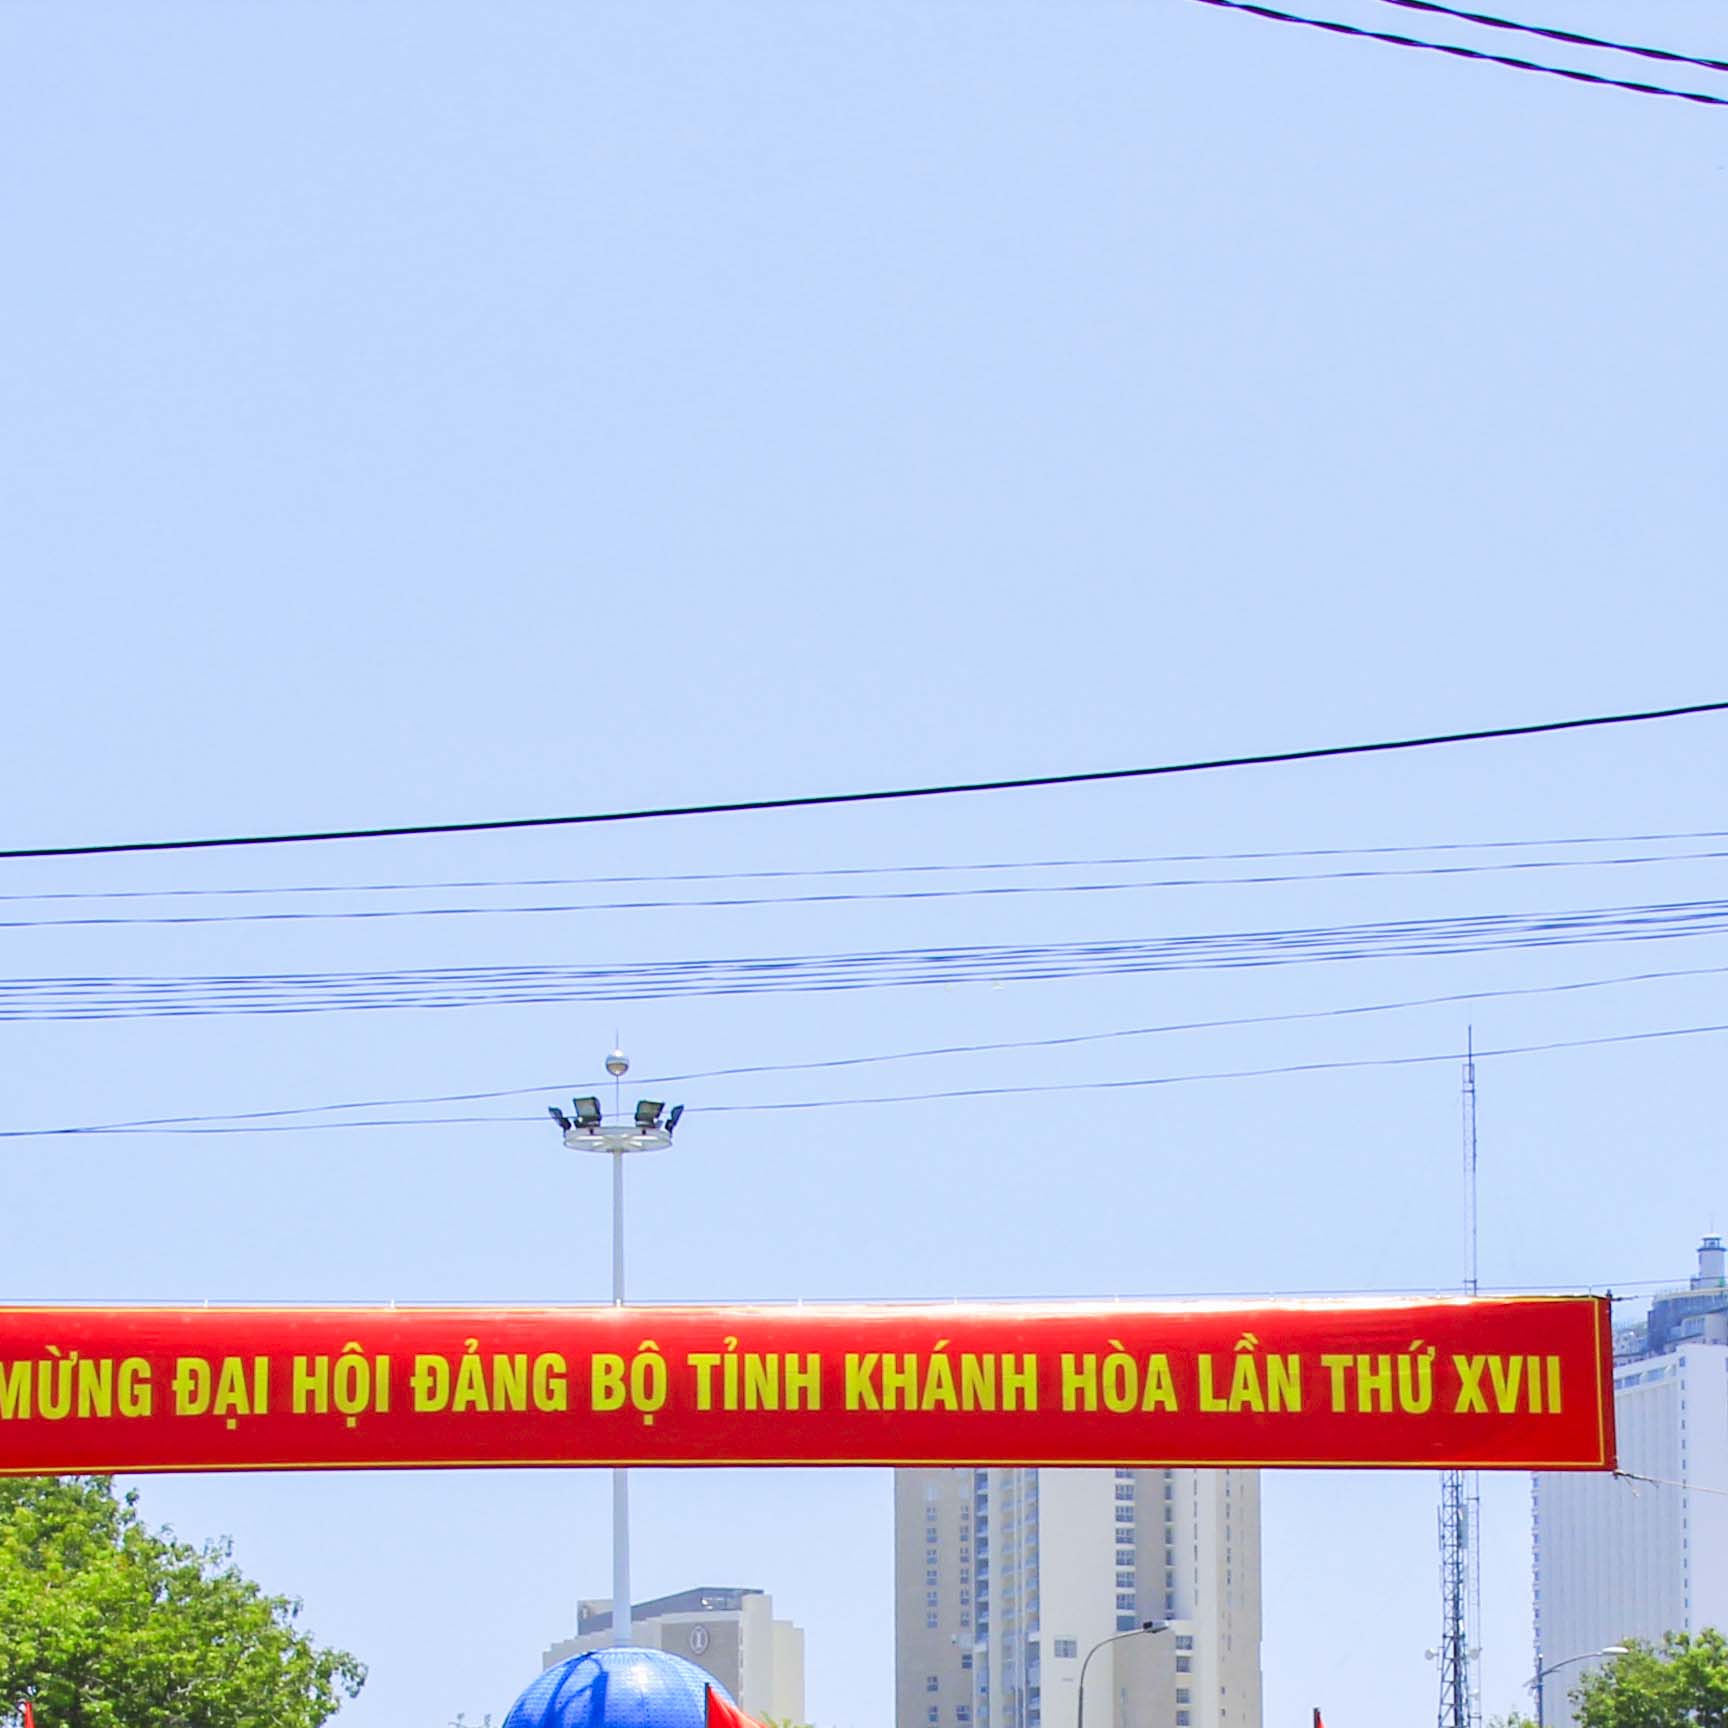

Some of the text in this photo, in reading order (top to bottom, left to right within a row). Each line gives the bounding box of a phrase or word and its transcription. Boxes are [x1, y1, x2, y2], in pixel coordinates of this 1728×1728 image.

[172, 1355, 269, 1430] ĐẠI
[291, 1341, 390, 1428] HỘI
[409, 1337, 568, 1412] ĐẢNG
[591, 1339, 668, 1425] BỘ
[687, 1335, 822, 1411] TỈNH
[844, 1339, 1038, 1411] KHÁNH
[1061, 1339, 1178, 1412] HÒA
[1197, 1331, 1301, 1412] LẦN
[1320, 1339, 1436, 1414] THỨ
[1451, 1354, 1563, 1414] XVII
